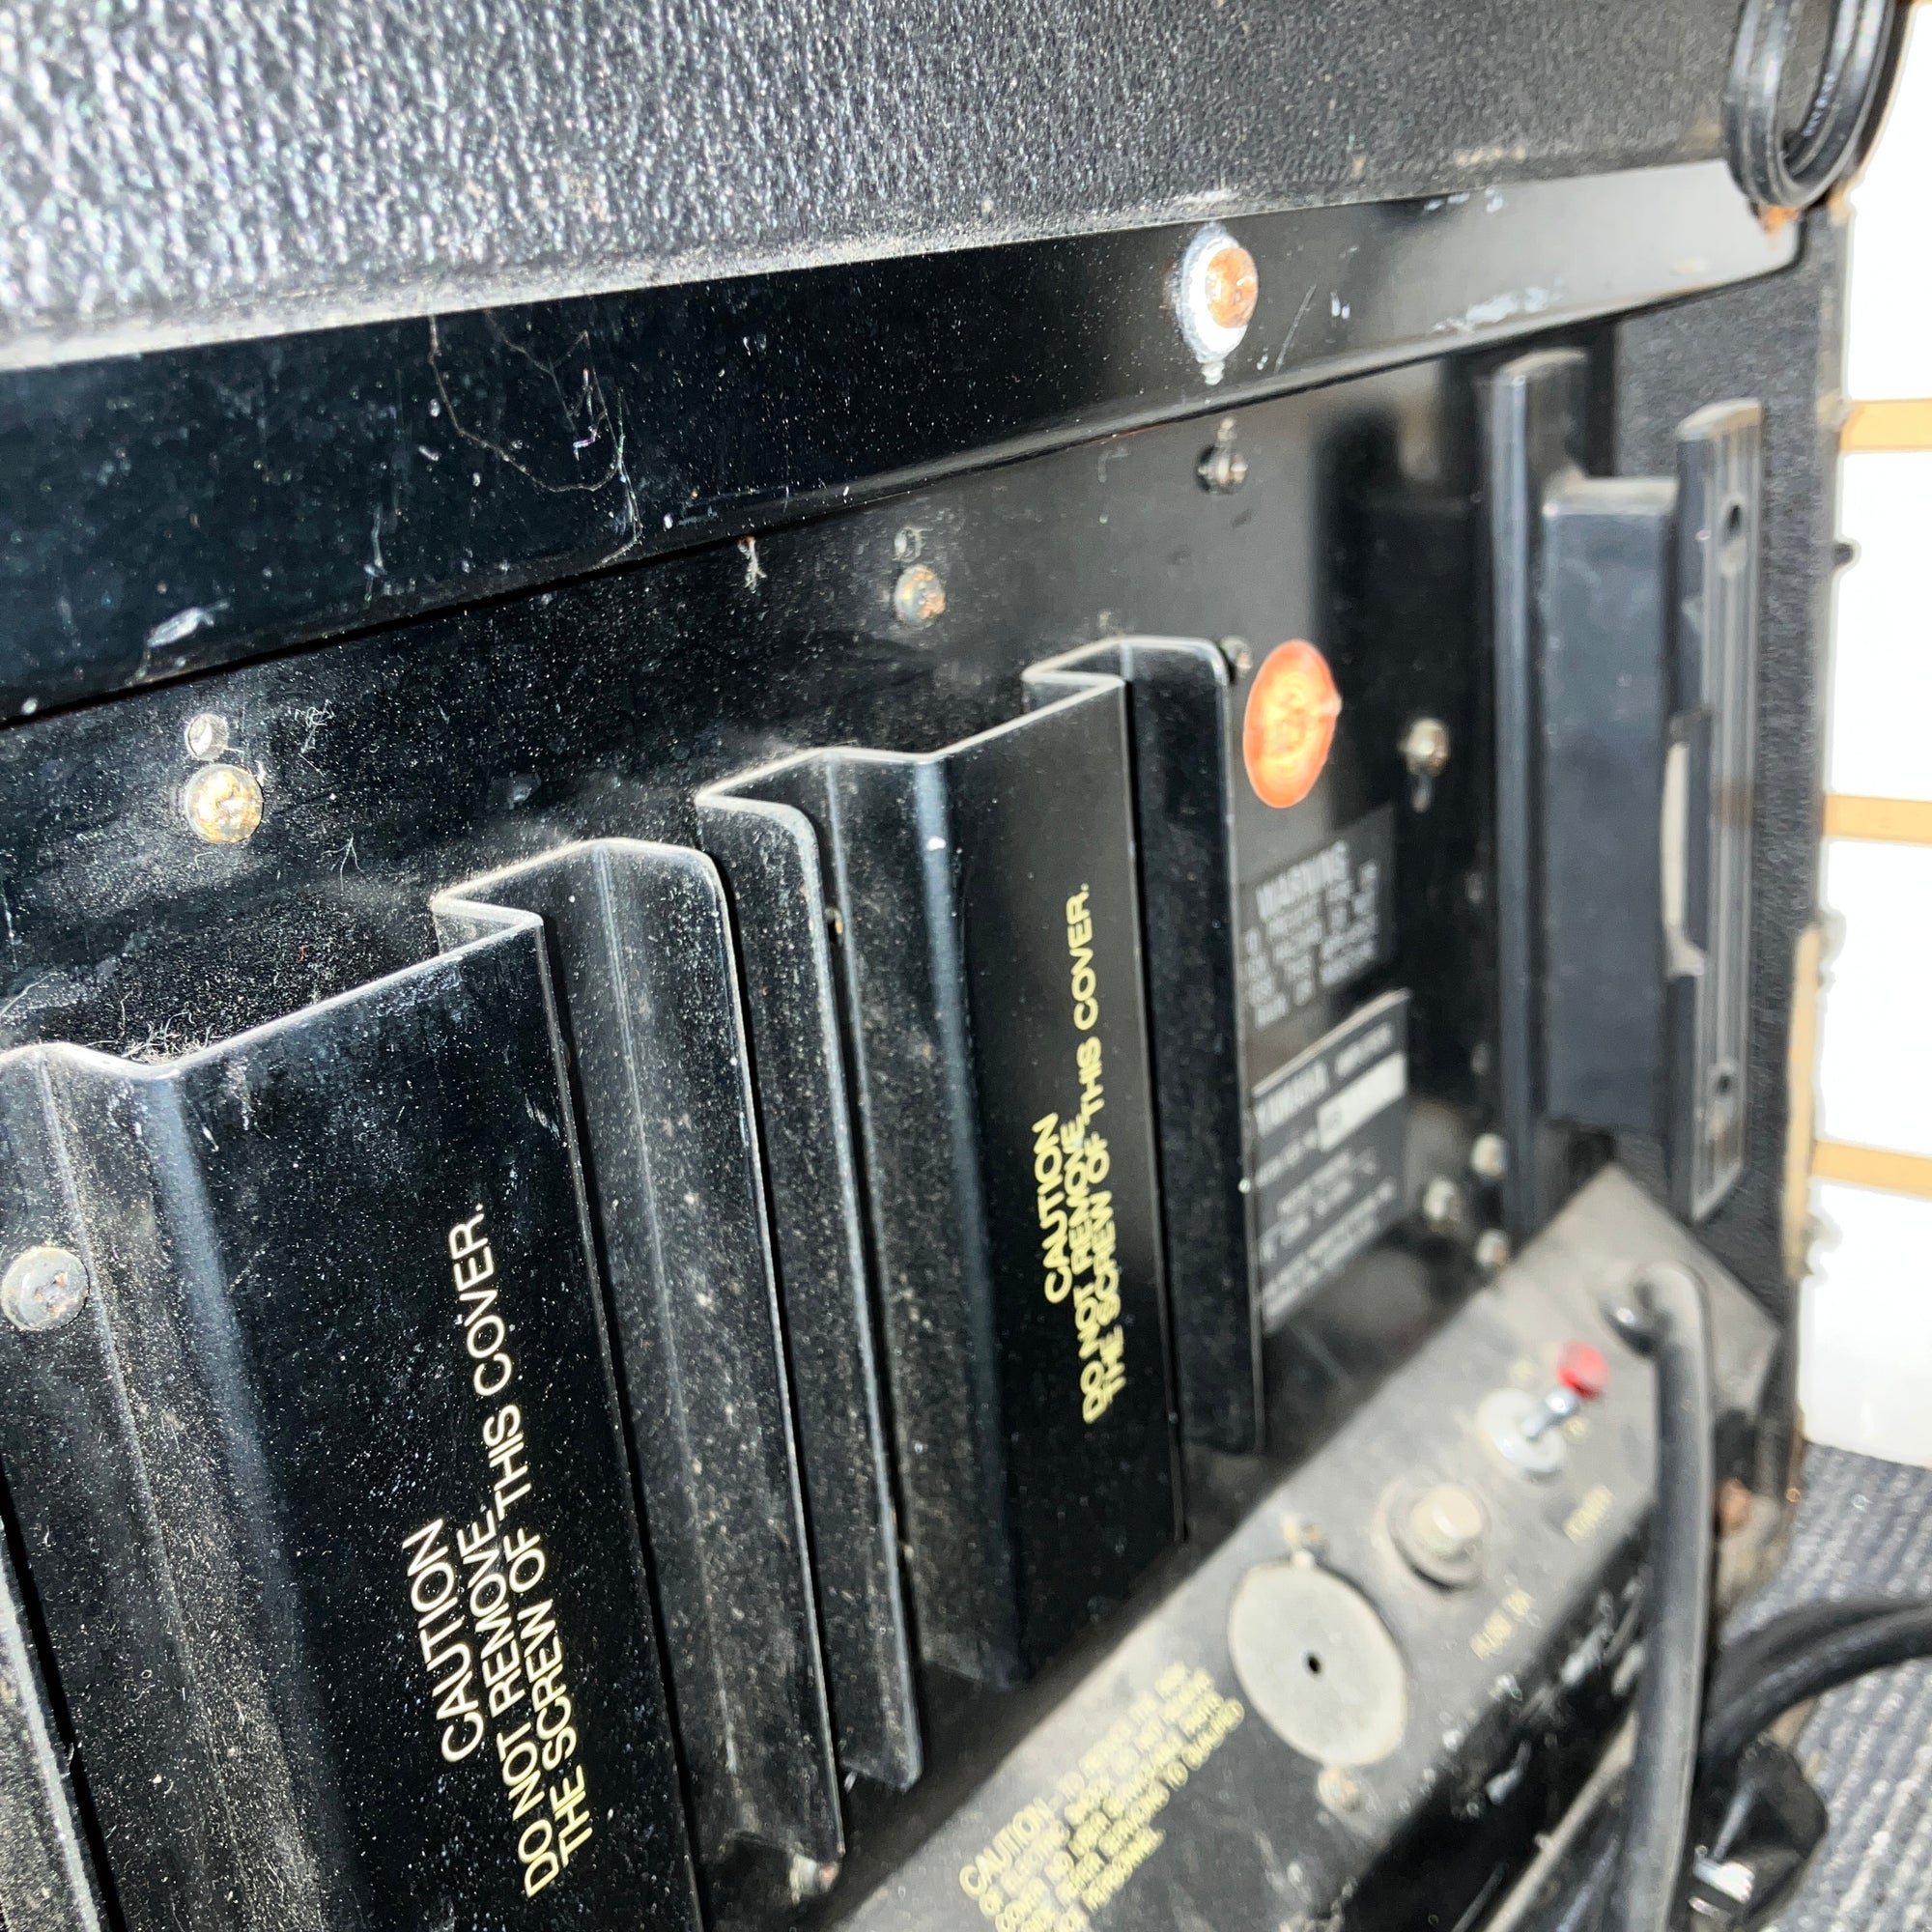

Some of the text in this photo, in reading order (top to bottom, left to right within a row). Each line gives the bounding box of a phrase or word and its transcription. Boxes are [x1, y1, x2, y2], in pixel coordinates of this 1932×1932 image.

[1032, 1112, 1073, 1303] CAUTION
[1060, 1113, 1108, 1424] DO NOT REMOVE
[1065, 882, 1127, 1405] THE SCREW OF THIS COVER.
[402, 1518, 485, 1763] CAUTION
[447, 1203, 594, 1868] THE SCREW OF THIS COVER.
[456, 1509, 560, 1898] DO NOT REMOVE
